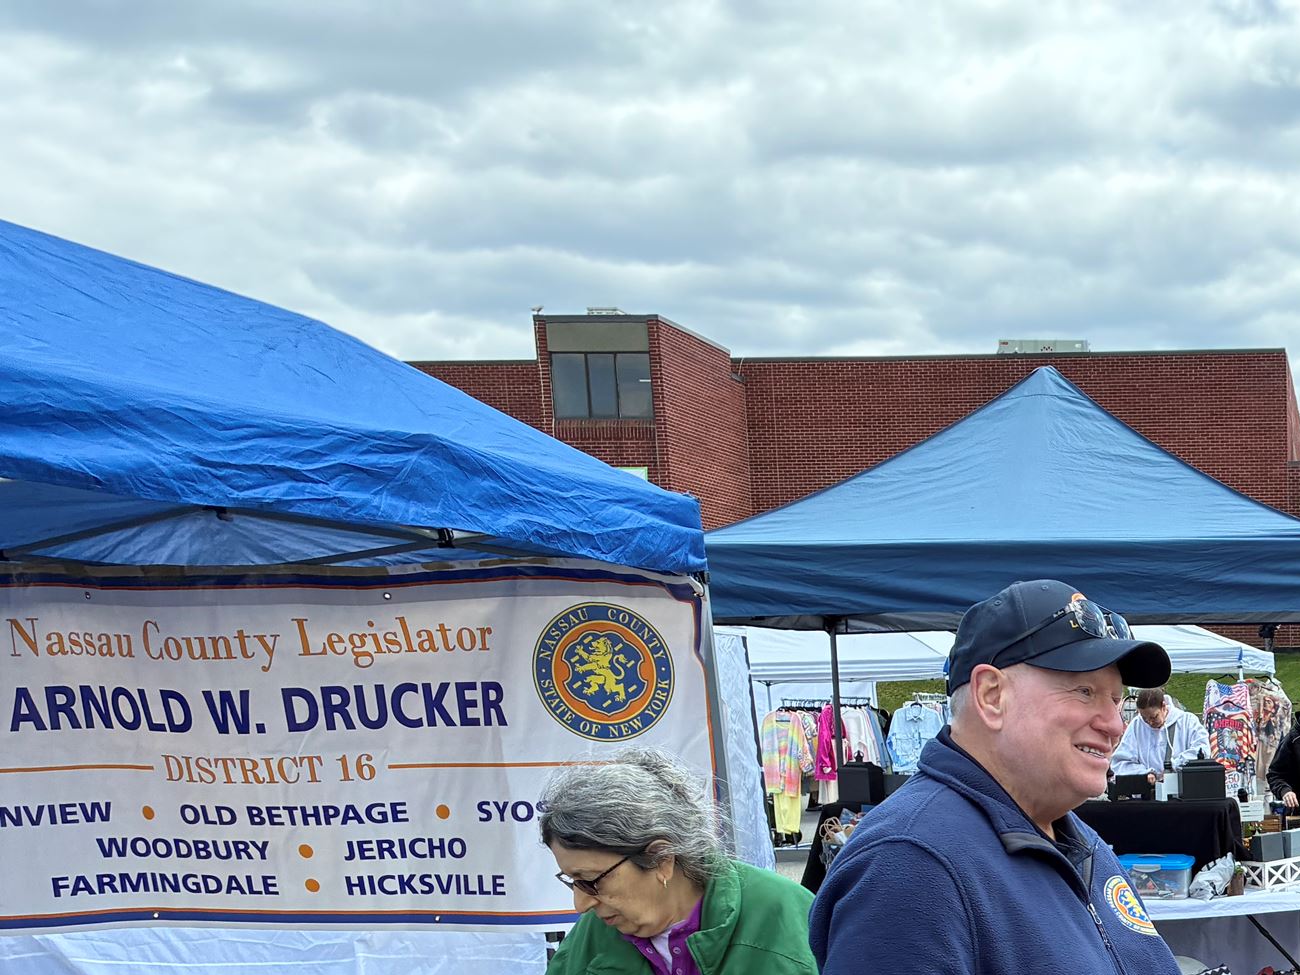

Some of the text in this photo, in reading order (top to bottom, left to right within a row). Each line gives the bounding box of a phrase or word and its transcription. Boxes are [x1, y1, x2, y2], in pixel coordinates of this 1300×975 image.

[5, 616, 493, 672] Nassau County Legislator
[539, 608, 666, 660] NASSAU COUNTY
[10, 681, 508, 735] ARNOLD W. DRUCKER
[540, 677, 670, 738] STATE OF NEW YORK
[161, 753, 377, 785] DISTRICT 16
[179, 804, 238, 826] OLD
[246, 801, 410, 827] BETHPAGE
[95, 837, 467, 861] WOODBURY JERICHO
[51, 872, 507, 898] FARMINGDALE HICKSVILLE
